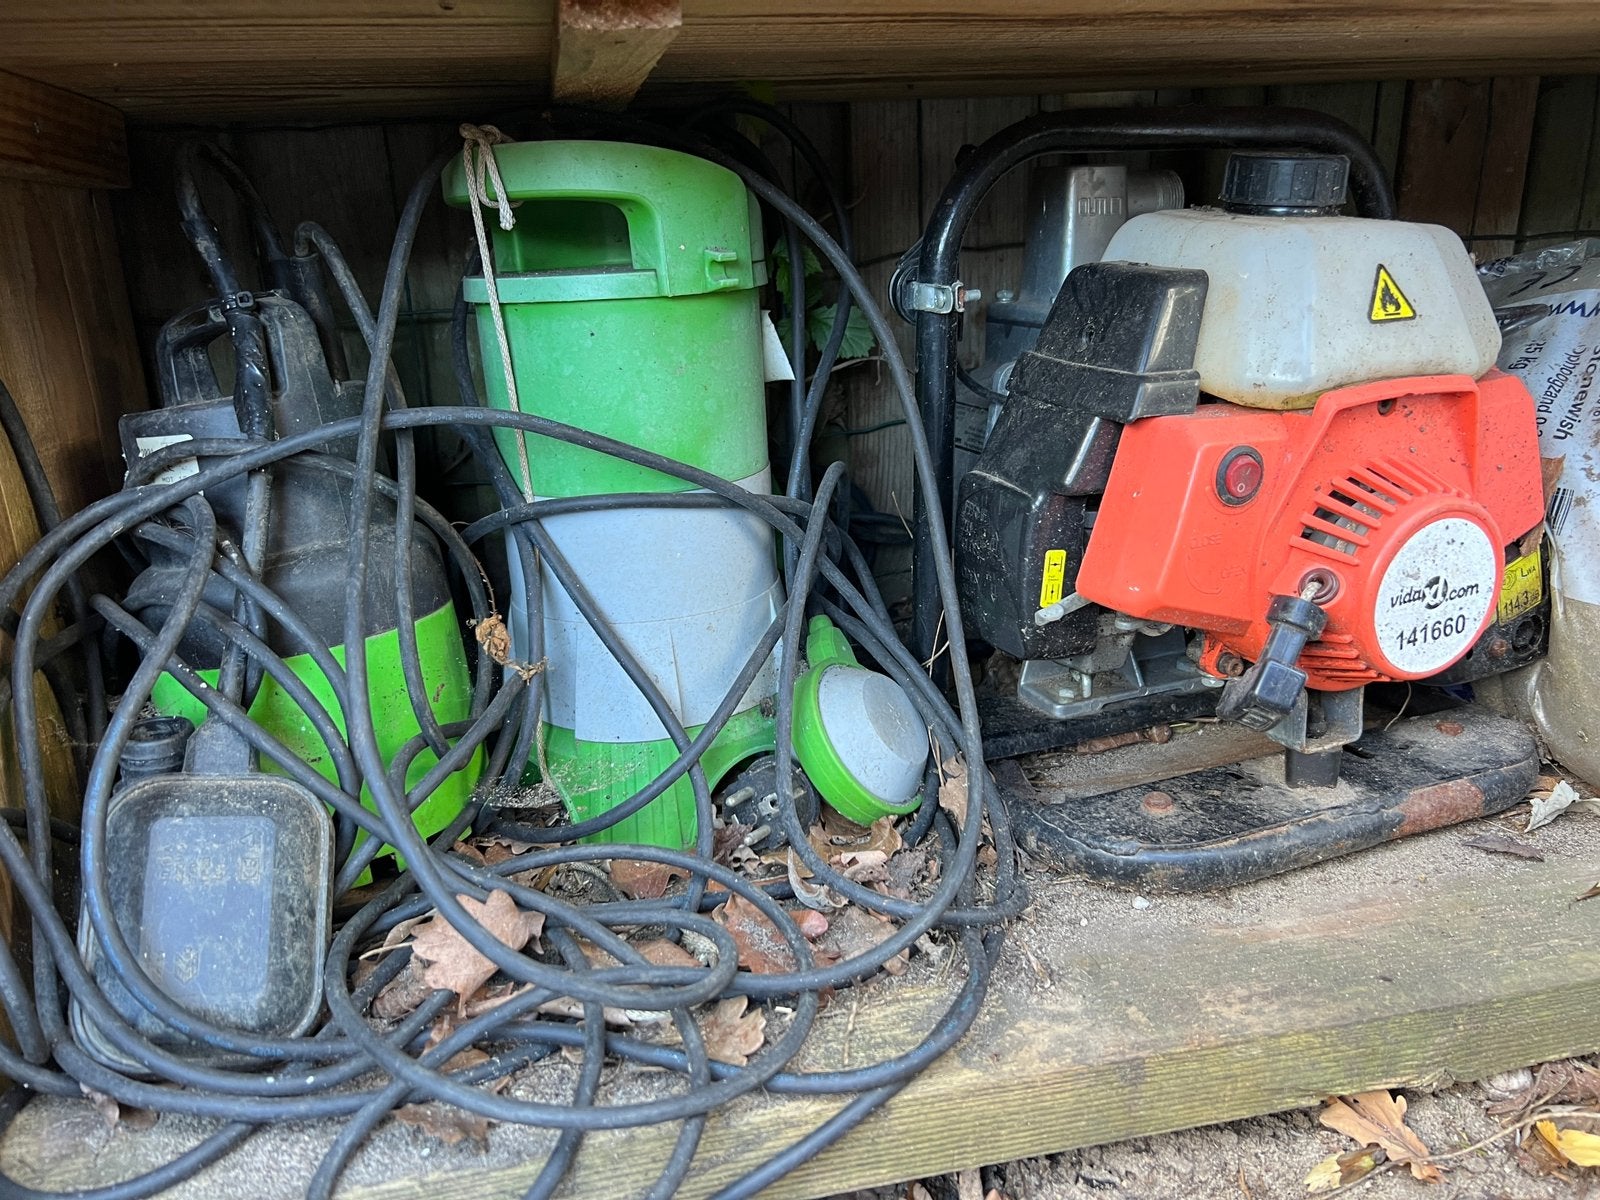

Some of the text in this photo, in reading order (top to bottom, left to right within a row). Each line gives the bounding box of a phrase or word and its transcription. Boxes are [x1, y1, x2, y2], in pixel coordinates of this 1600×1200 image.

[1508, 356, 1538, 370] kg
[1537, 344, 1587, 414] Ophoogzand
[1503, 590, 1530, 617] 114.3
[1396, 613, 1466, 651] 141660
